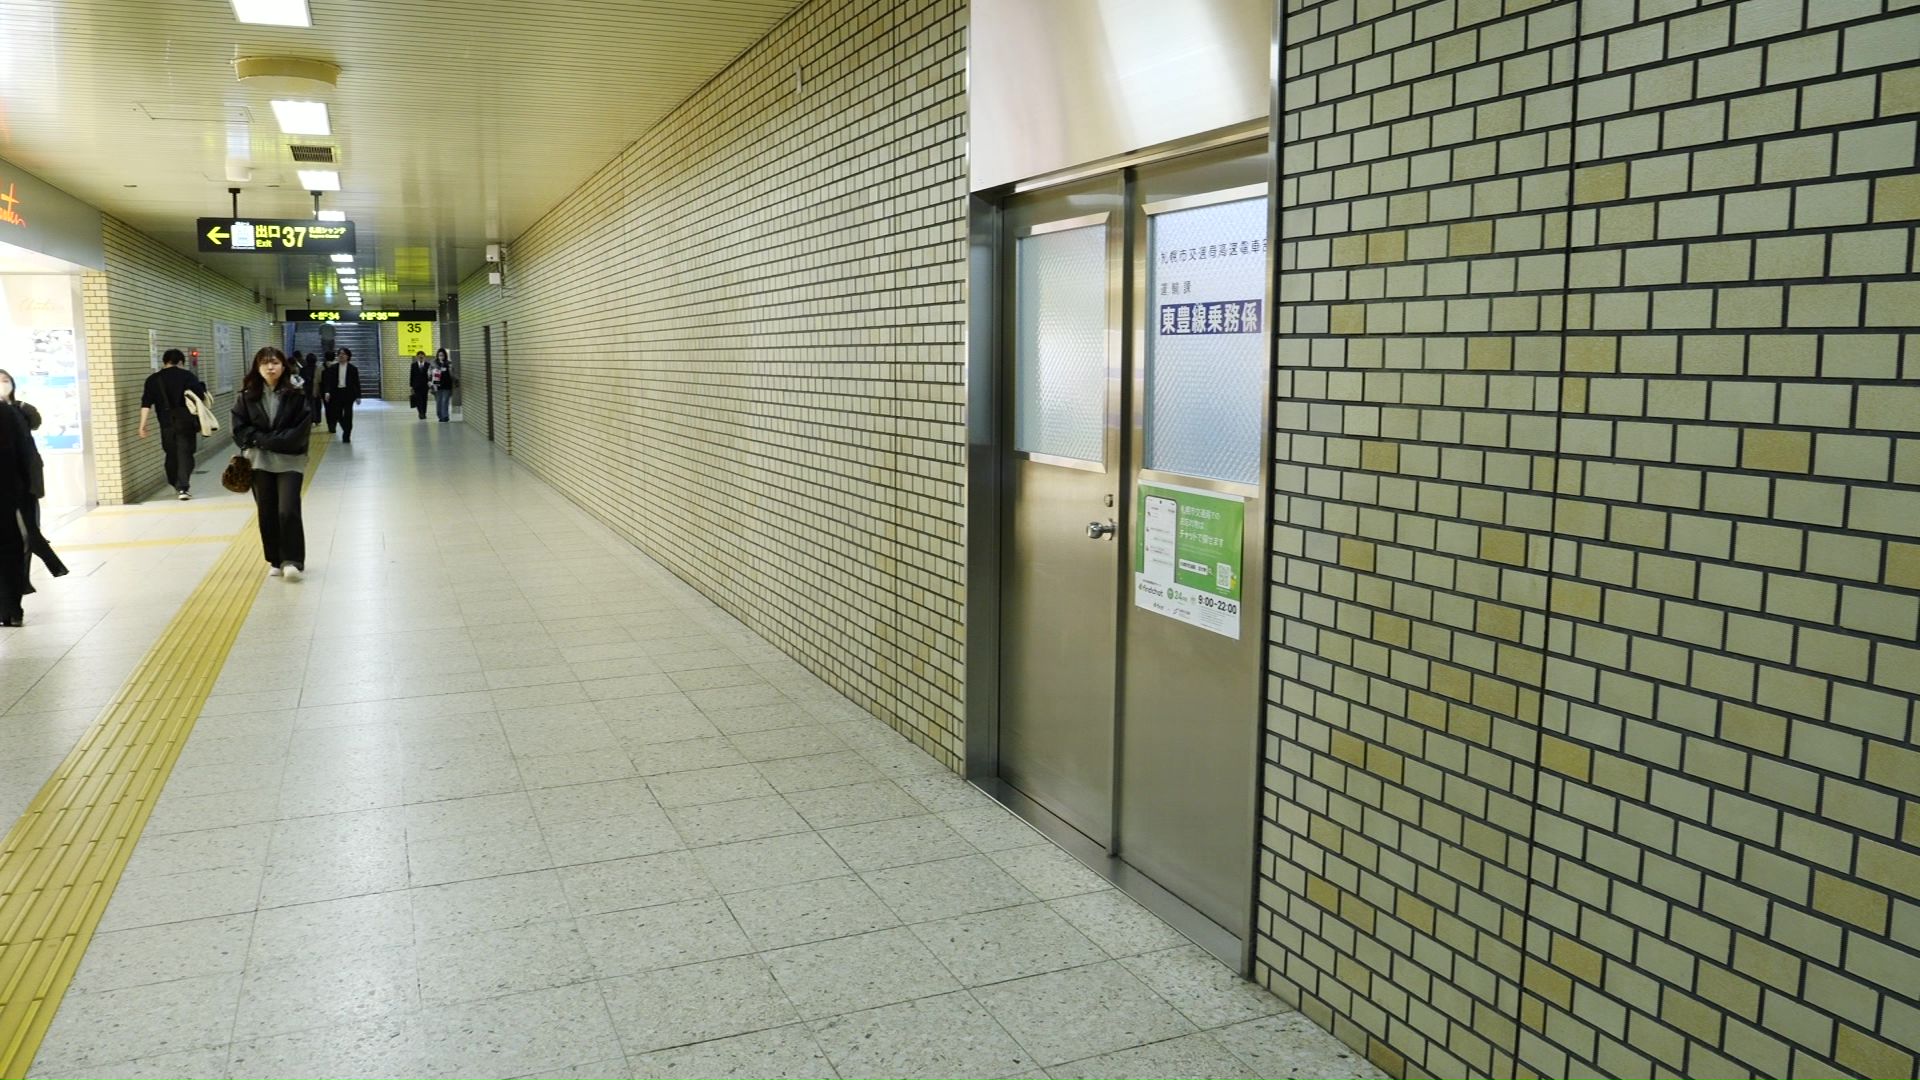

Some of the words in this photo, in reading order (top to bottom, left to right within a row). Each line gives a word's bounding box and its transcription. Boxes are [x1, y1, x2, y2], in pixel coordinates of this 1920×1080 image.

[256, 225, 281, 238] 出口
[282, 226, 307, 248] 37
[256, 239, 273, 248] Exit
[1161, 301, 1258, 334] 東豊線乗務係
[407, 323, 422, 333] 35
[1198, 595, 1238, 614] 9:00-22:00
